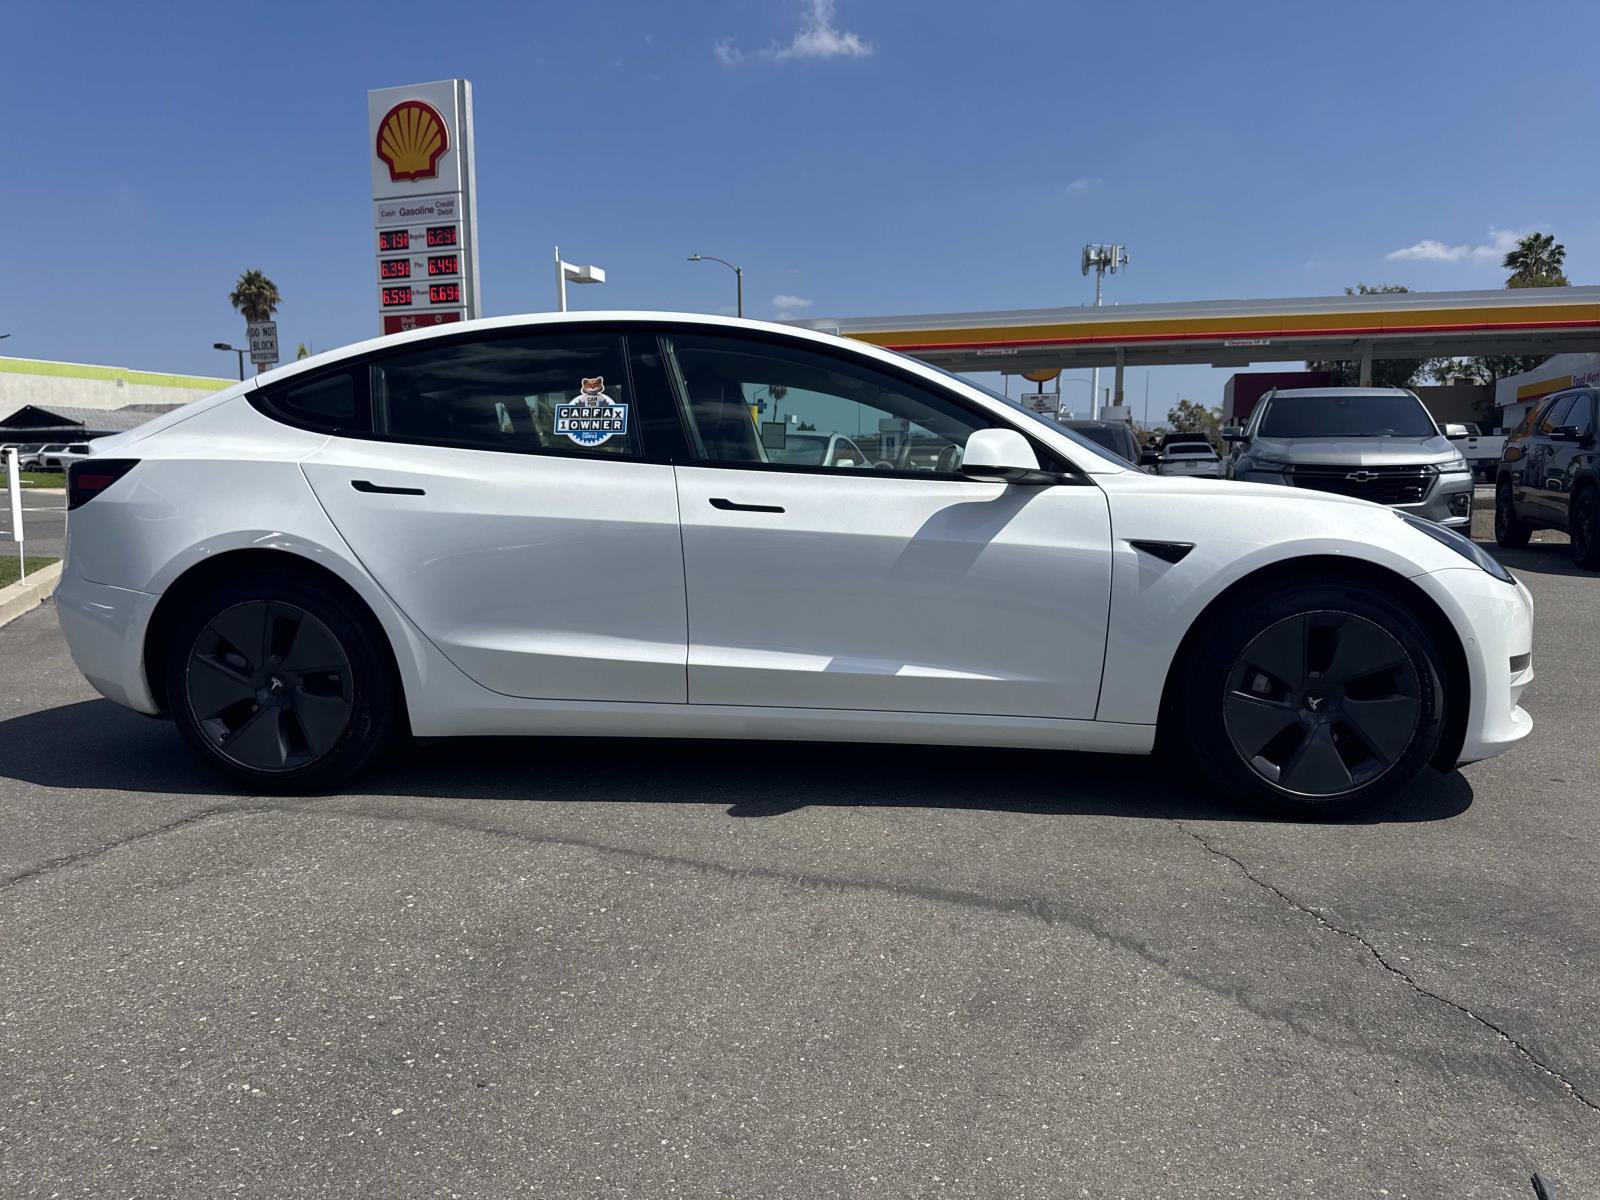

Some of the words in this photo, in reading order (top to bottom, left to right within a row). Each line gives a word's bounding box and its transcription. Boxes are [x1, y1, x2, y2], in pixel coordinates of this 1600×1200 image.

[381, 209, 396, 218] Cash
[399, 205, 435, 217] Gasoline
[437, 208, 453, 216] Debit
[251, 328, 259, 337] DO
[262, 327, 275, 336] NOT
[253, 340, 275, 351] BLOCK
[1573, 373, 1586, 386] Food
[560, 409, 623, 418] CARFAX
[560, 421, 566, 429] 1
[570, 420, 622, 430] OWNER
